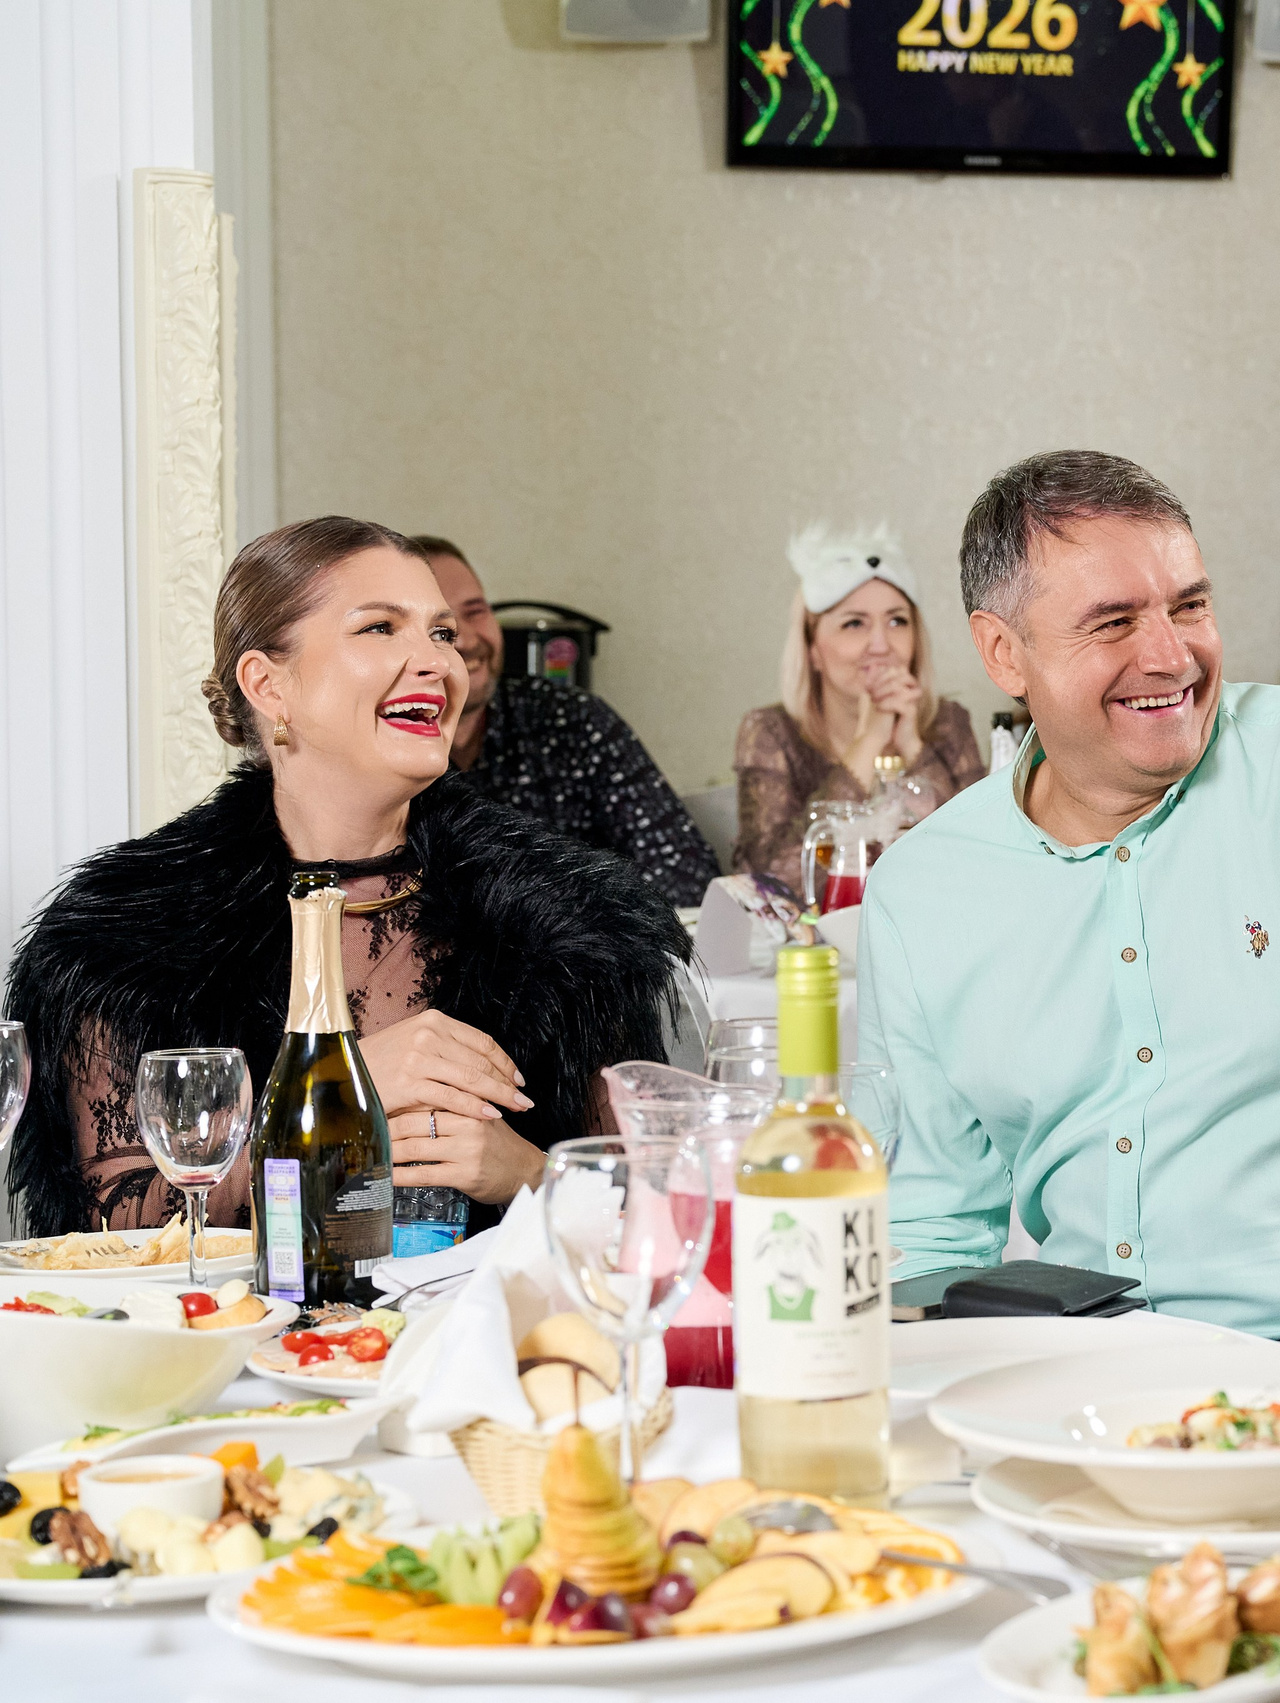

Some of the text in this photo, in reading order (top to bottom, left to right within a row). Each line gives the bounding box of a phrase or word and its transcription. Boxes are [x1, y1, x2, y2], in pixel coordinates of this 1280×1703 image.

[897, 0, 1078, 51] 2026
[897, 50, 1074, 76] HAPPY NEW YEAR
